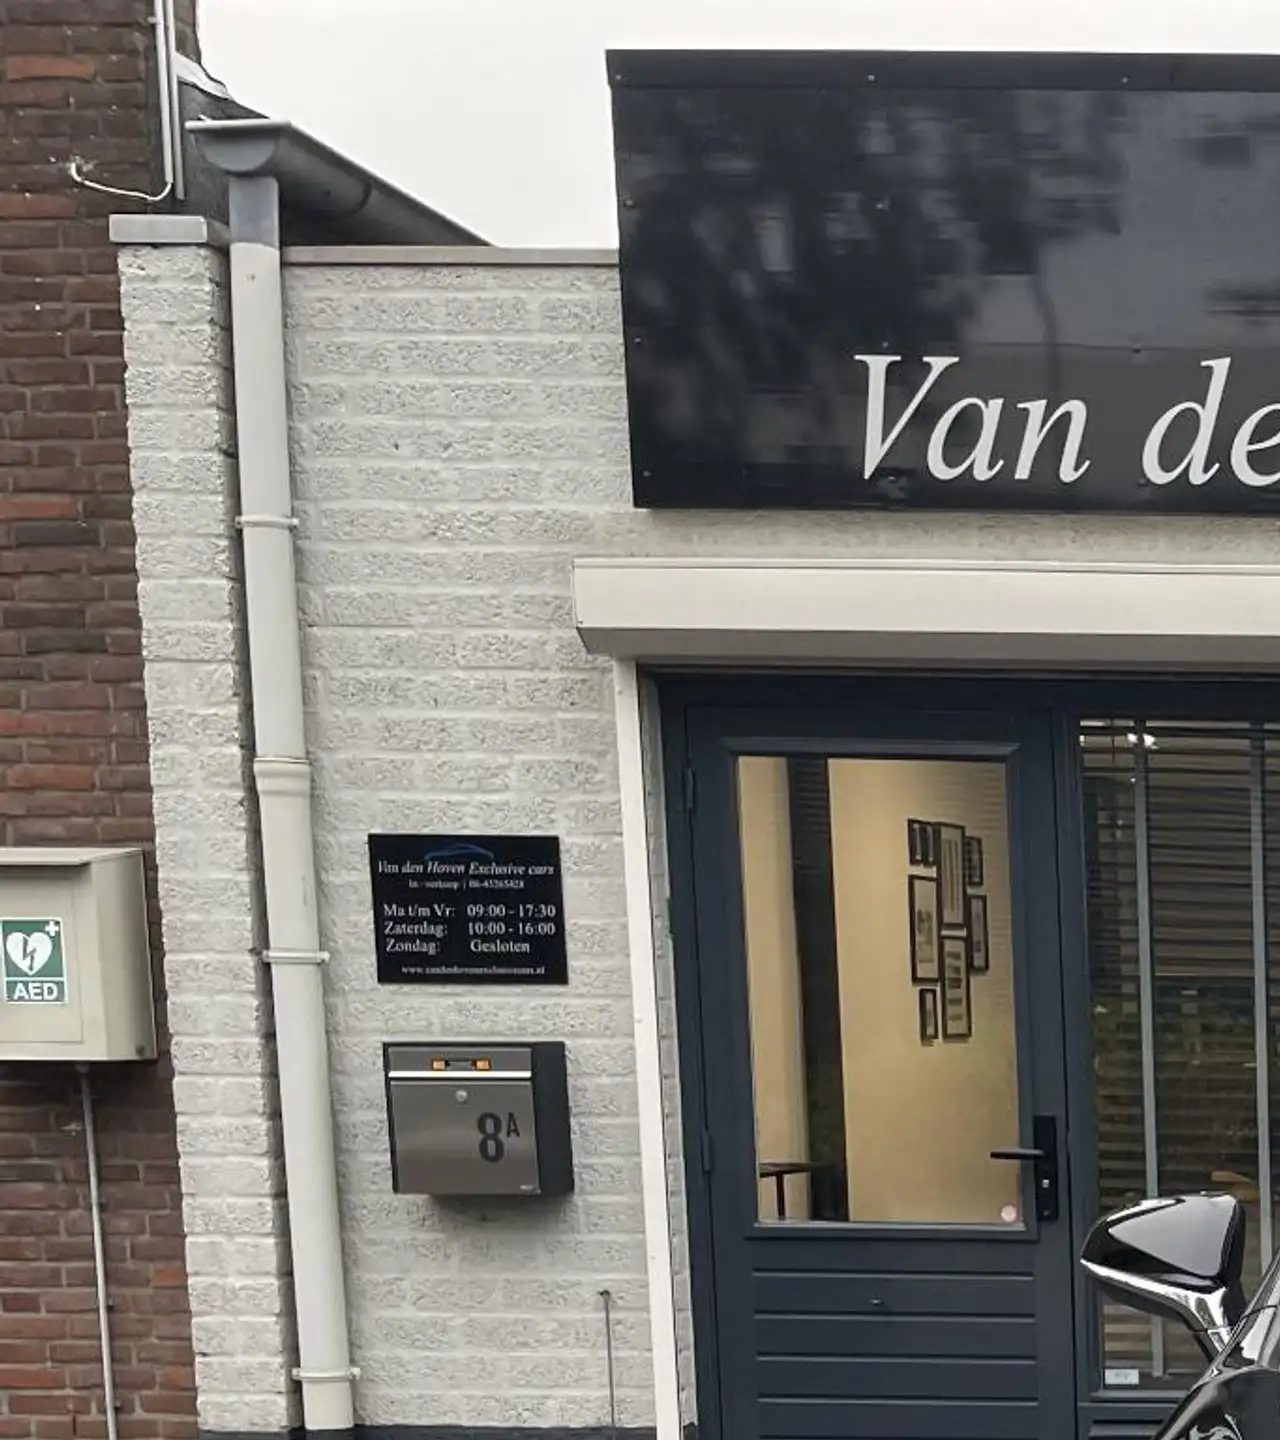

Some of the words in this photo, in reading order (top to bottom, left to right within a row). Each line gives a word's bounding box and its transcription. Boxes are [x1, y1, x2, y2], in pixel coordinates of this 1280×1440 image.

[854, 354, 1090, 483] Van
[401, 861, 423, 873] den
[426, 862, 465, 874] Hoven
[468, 862, 525, 876] Exclusive
[528, 864, 554, 875] cars
[384, 904, 405, 917] Ma
[408, 904, 430, 917] t/m
[433, 904, 455, 917] Vr:
[467, 904, 506, 917] 09:00
[518, 904, 556, 918] 17:30
[384, 921, 448, 938] Zaterdag:
[468, 922, 506, 935] 10:00
[518, 922, 556, 936] 16:00
[386, 938, 440, 955] Zondag:
[470, 938, 530, 953] Gesloten
[13, 981, 59, 1002] AED
